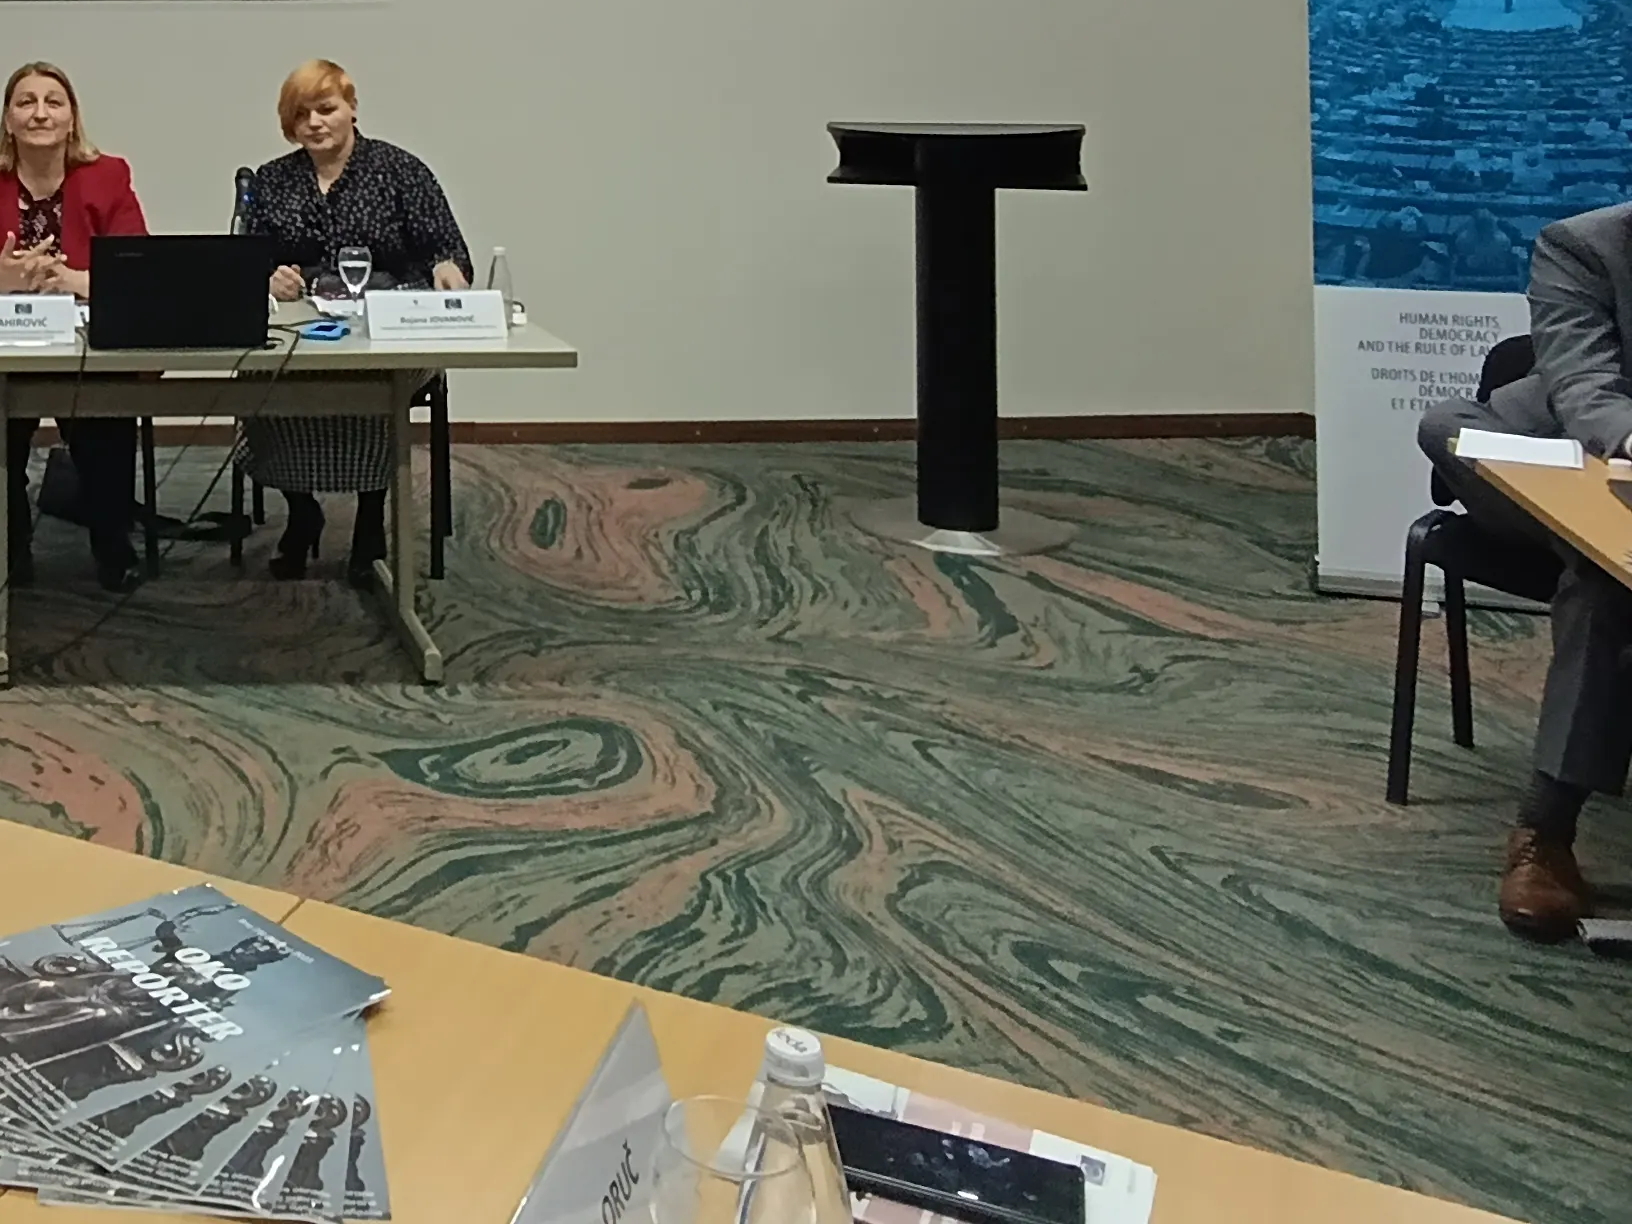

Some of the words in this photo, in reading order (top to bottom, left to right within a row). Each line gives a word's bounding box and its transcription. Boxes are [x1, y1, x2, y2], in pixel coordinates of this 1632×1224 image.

[1399, 313, 1448, 325] HUMAN
[1419, 328, 1498, 343] DEMOCRACY
[1358, 340, 1385, 352] AND
[1388, 341, 1410, 353] THE
[1415, 342, 1446, 355] RULE
[1450, 344, 1466, 356] OF
[1371, 368, 1417, 382] DROITS
[1420, 370, 1435, 383] DE
[1440, 372, 1481, 384] L'HOM
[1391, 398, 1404, 410] ET
[173, 946, 252, 993] OKO
[78, 935, 245, 1042] REPORTER
